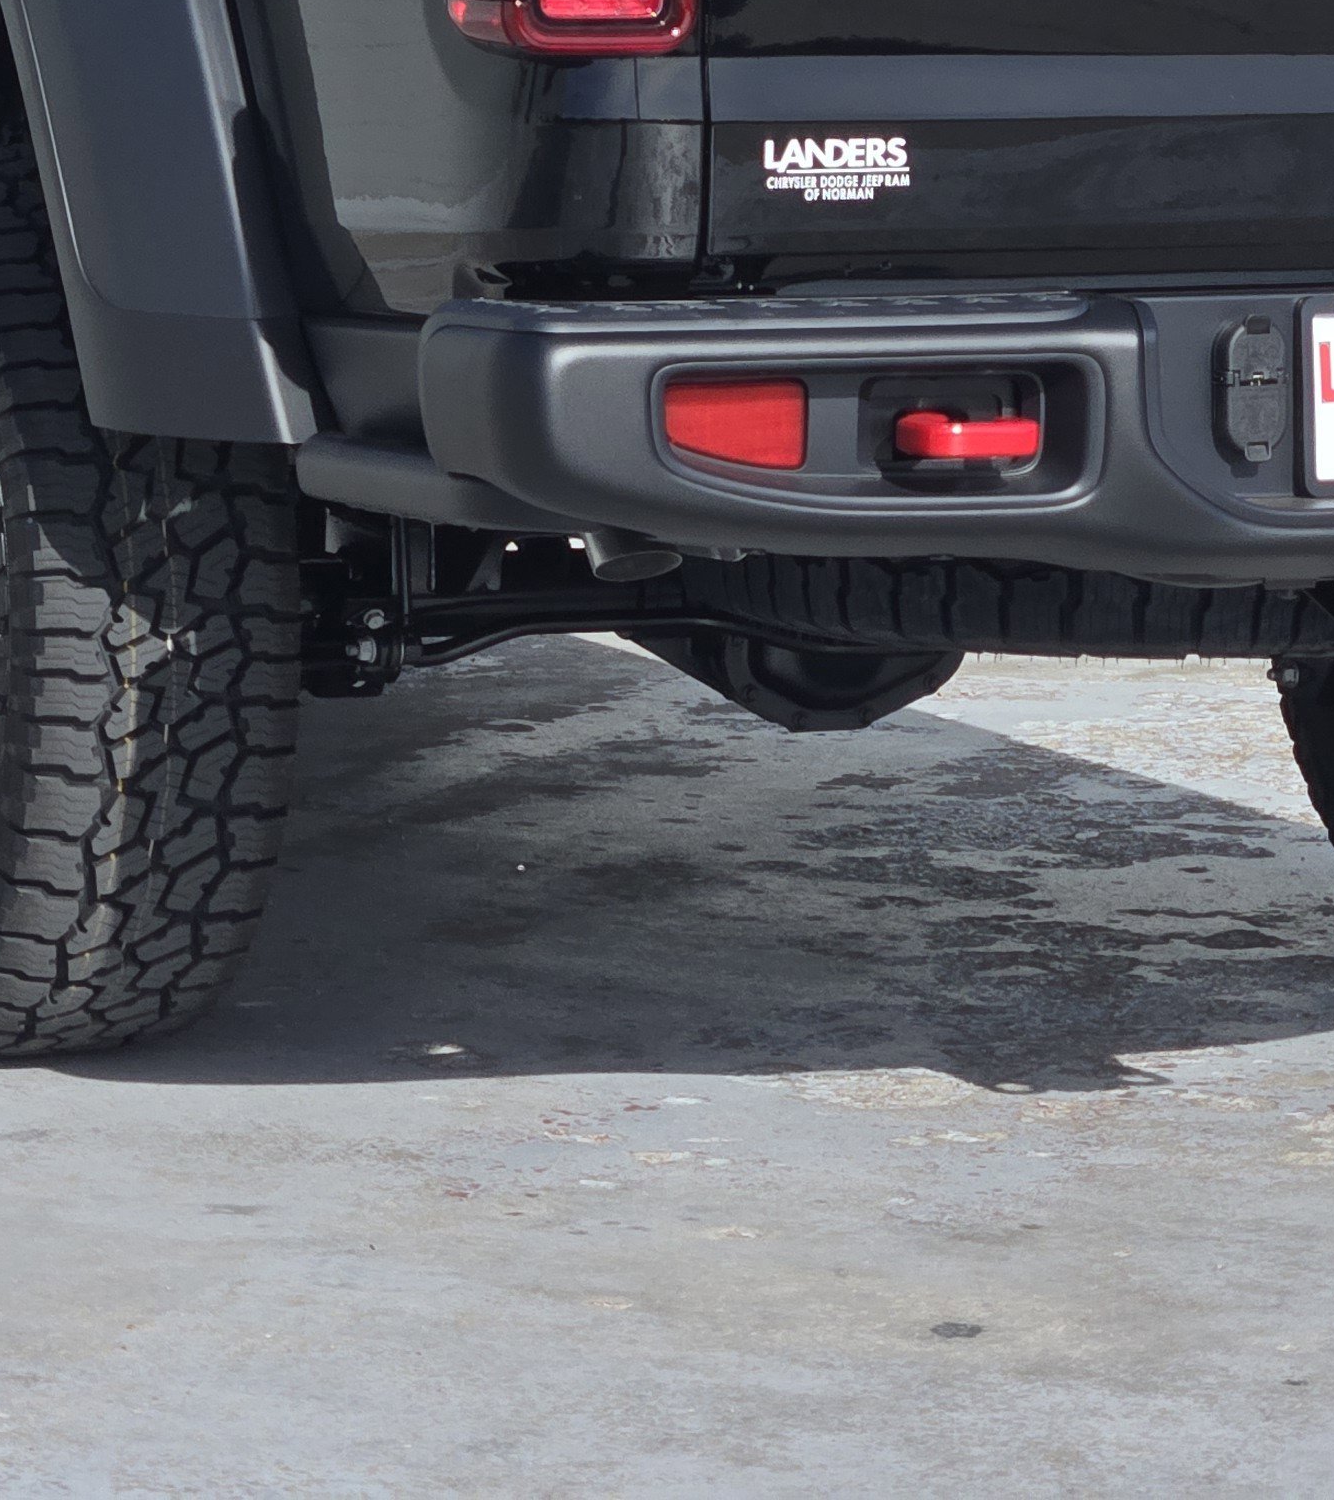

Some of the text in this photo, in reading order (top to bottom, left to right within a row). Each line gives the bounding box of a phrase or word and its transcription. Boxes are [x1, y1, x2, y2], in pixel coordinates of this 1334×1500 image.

[764, 137, 907, 173] LANDERS
[766, 173, 910, 189] CHRYSLER DODGE JEEP RAM
[804, 187, 874, 201] OF NORMAN
